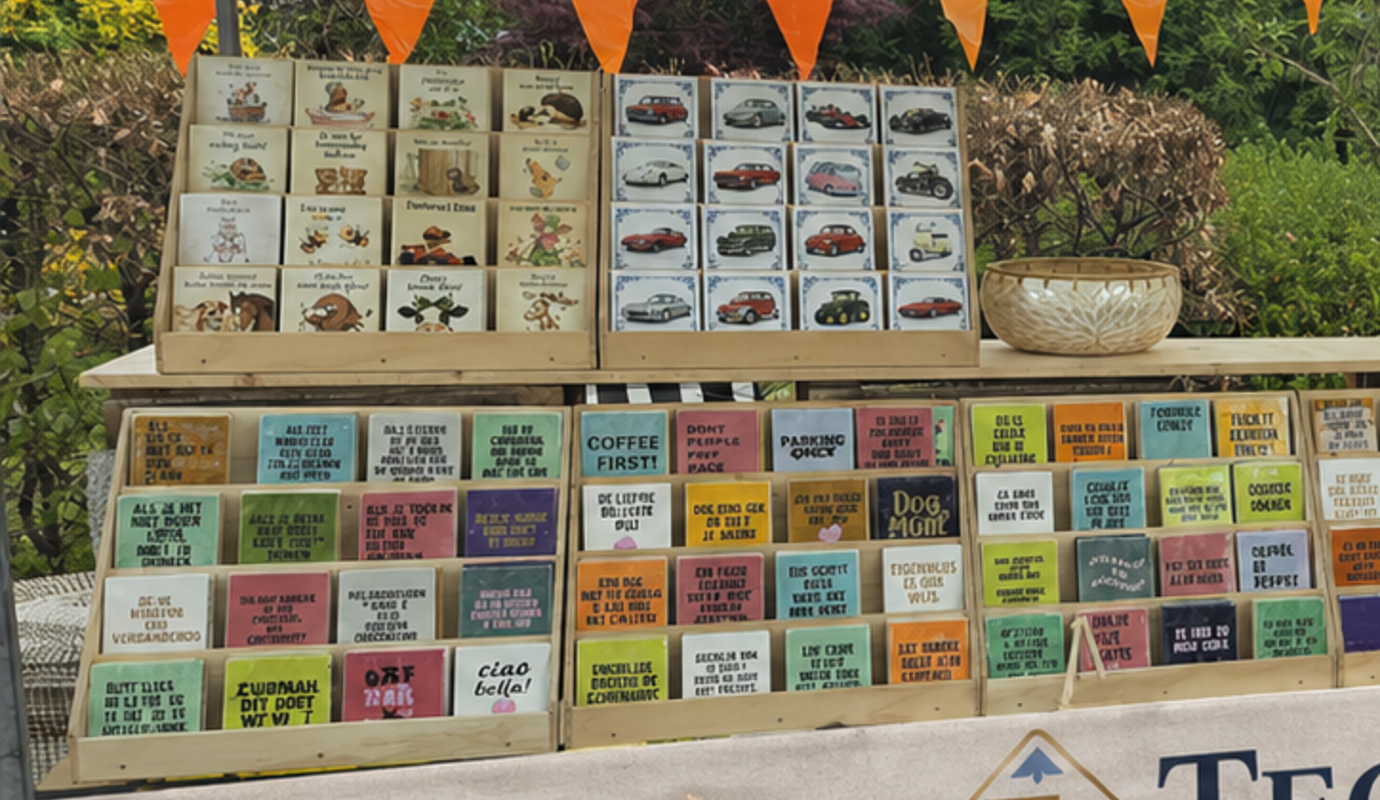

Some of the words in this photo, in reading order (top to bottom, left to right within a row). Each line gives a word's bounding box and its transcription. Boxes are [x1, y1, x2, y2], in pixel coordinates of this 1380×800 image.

[587, 435, 660, 451] COFFEE
[597, 455, 658, 471] FIRST!
[478, 661, 532, 679] ciao
[473, 678, 533, 698] bella!
